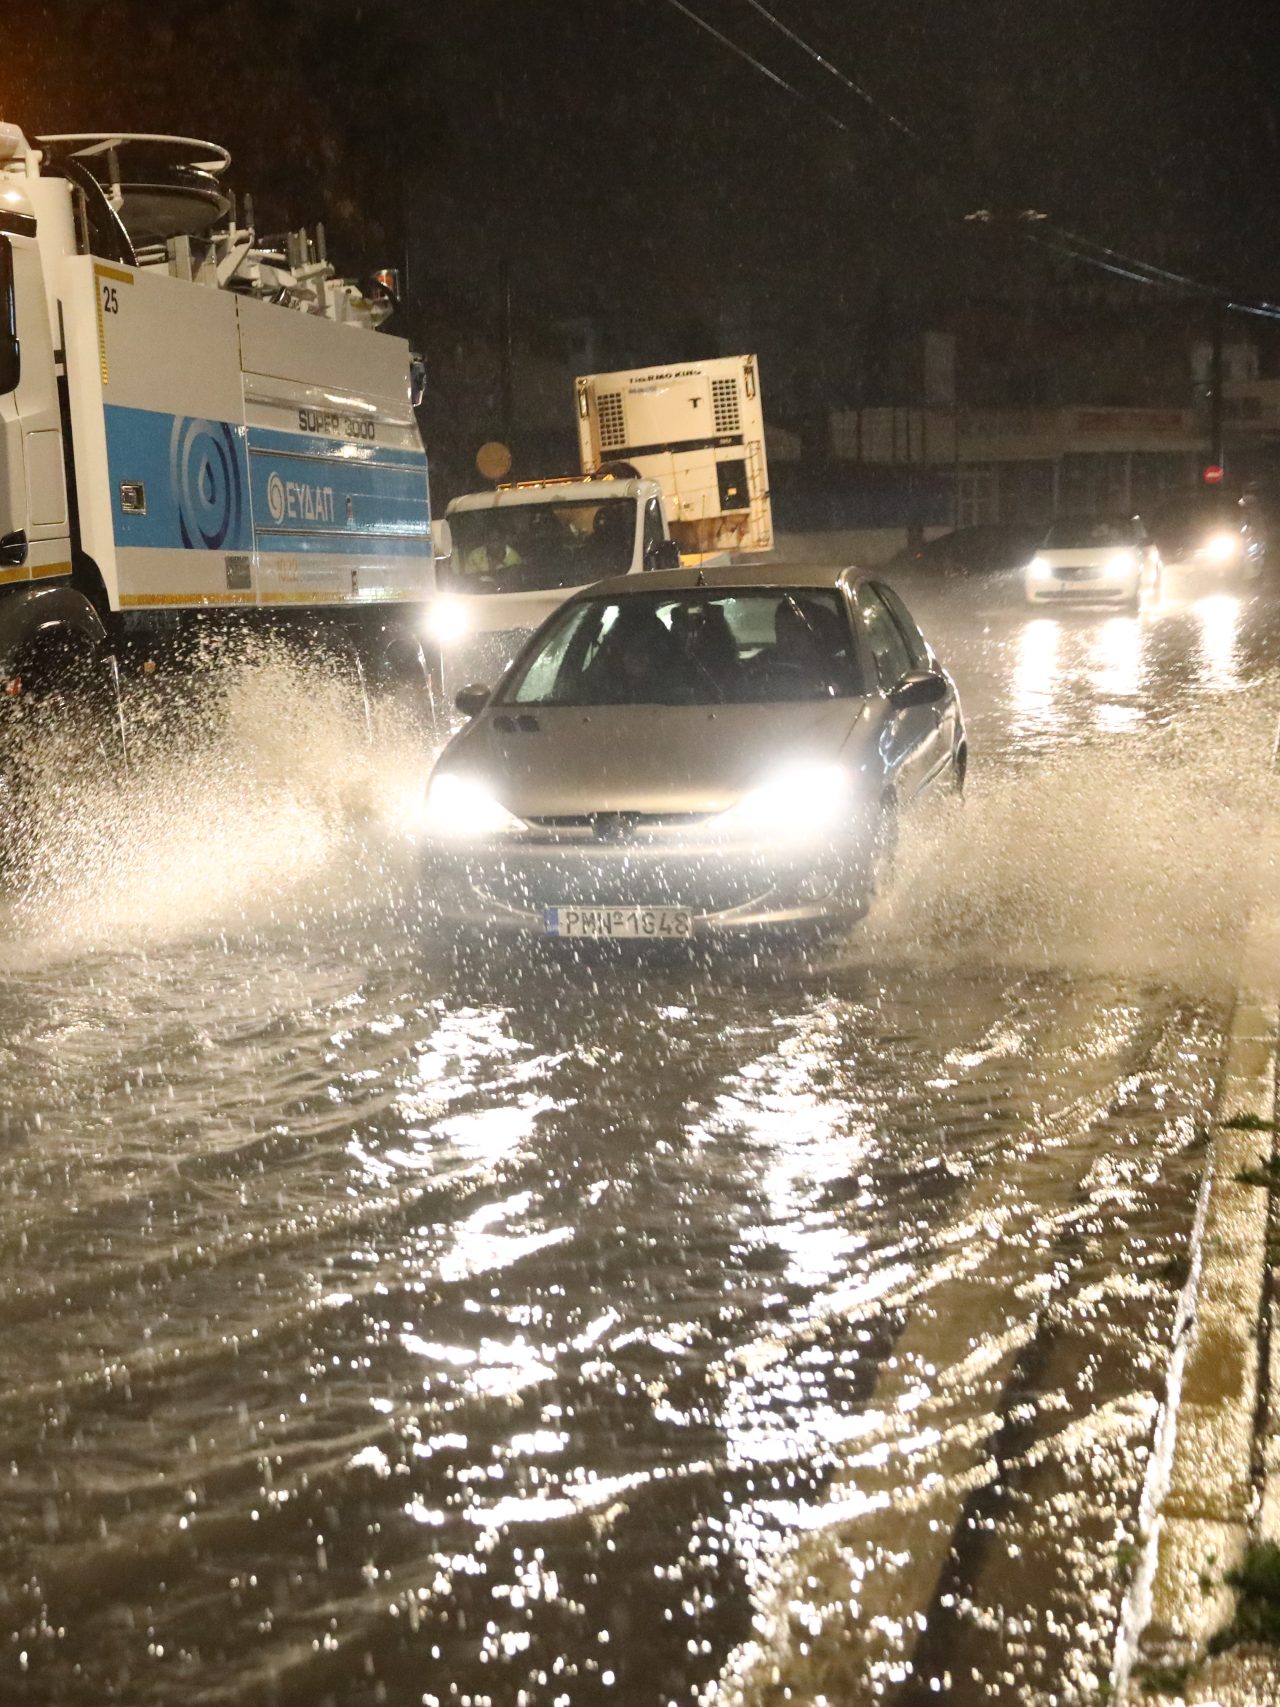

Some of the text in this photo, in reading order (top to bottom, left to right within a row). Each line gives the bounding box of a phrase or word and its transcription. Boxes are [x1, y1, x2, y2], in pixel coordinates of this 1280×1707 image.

[103, 286, 118, 314] 25
[299, 409, 375, 440] SUPER 3000
[286, 482, 334, 522] ΕΥΔΑΠ
